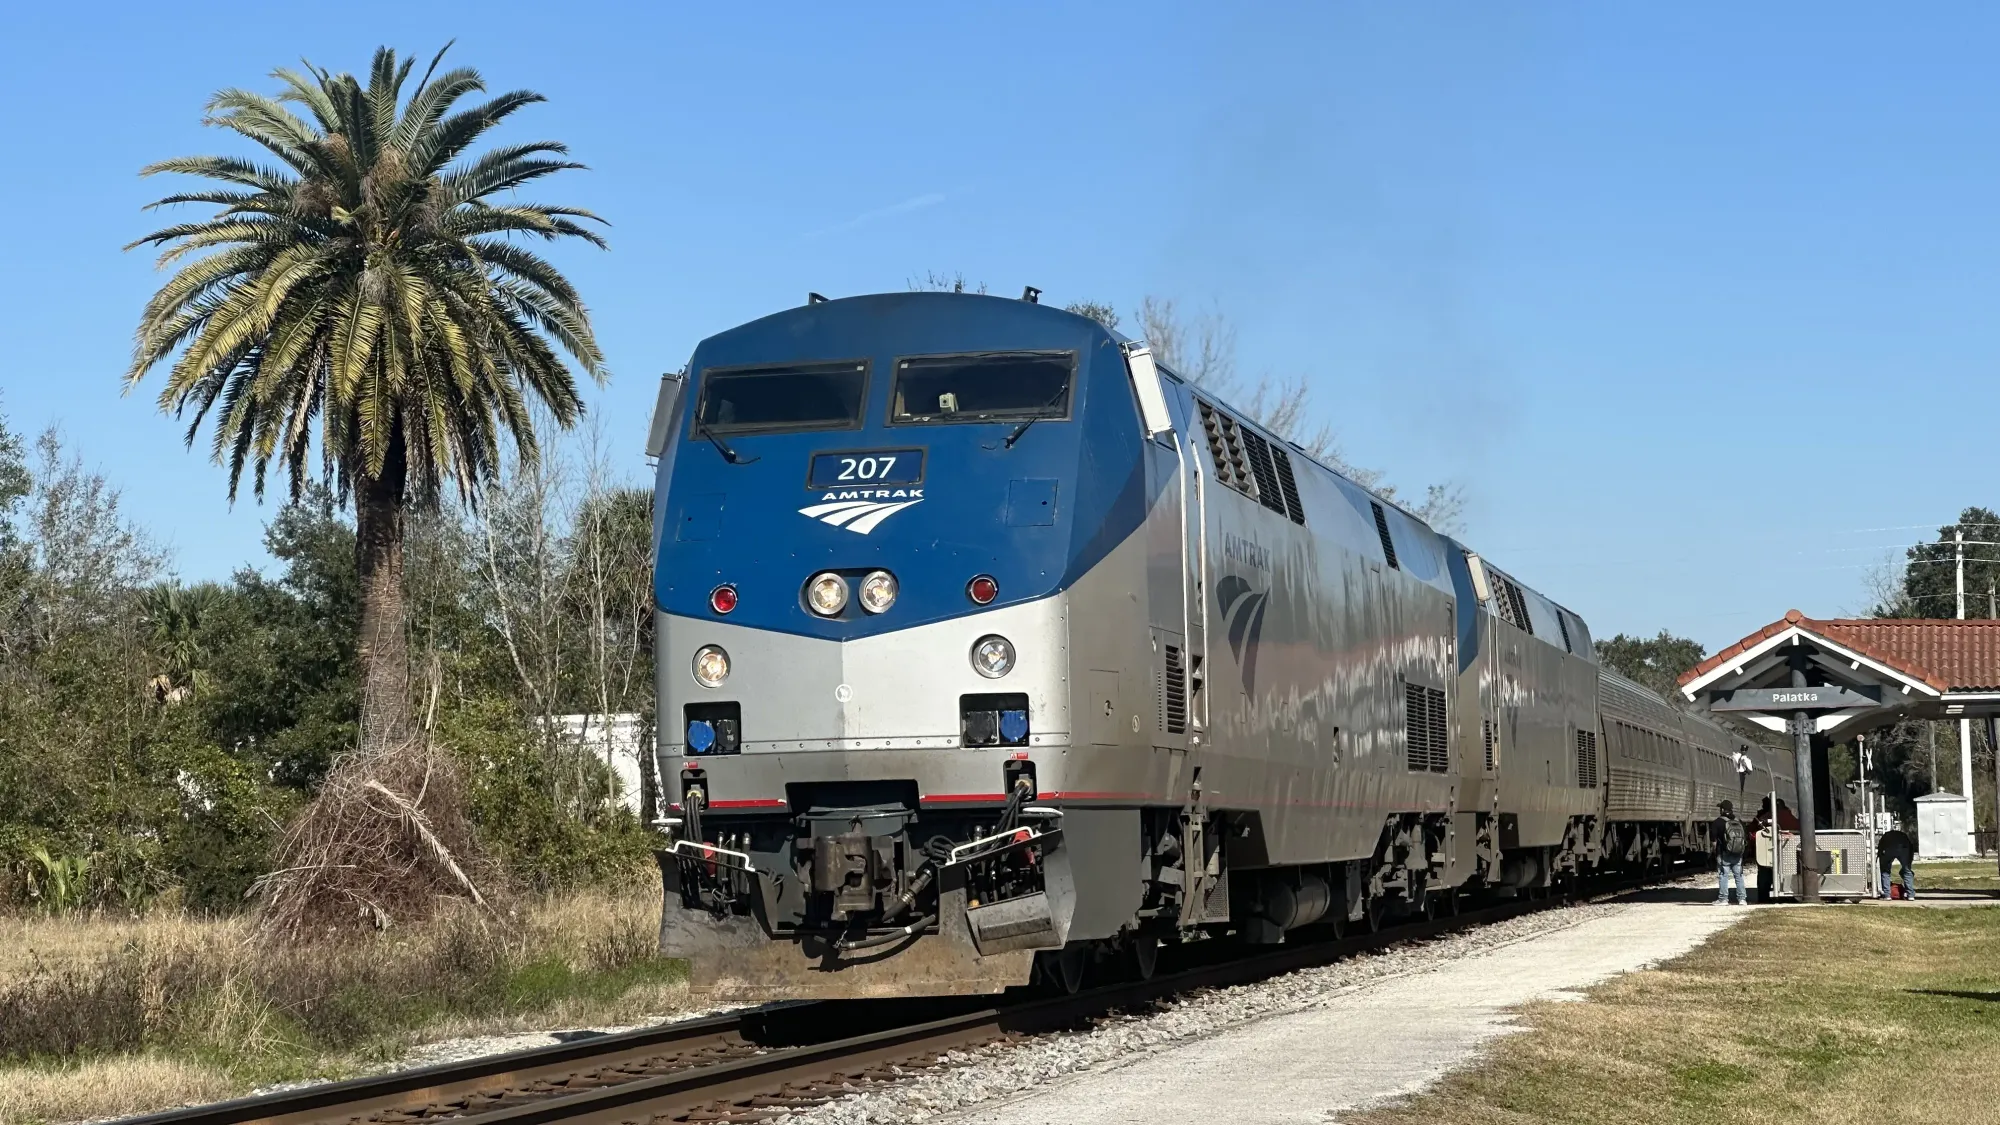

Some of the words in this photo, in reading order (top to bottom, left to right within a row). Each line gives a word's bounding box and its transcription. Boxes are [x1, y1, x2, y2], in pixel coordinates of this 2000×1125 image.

[838, 457, 896, 480] 207
[821, 489, 924, 501] AMTRAK
[1224, 532, 1271, 572] AMTRAK
[1772, 692, 1818, 703] Palatka
